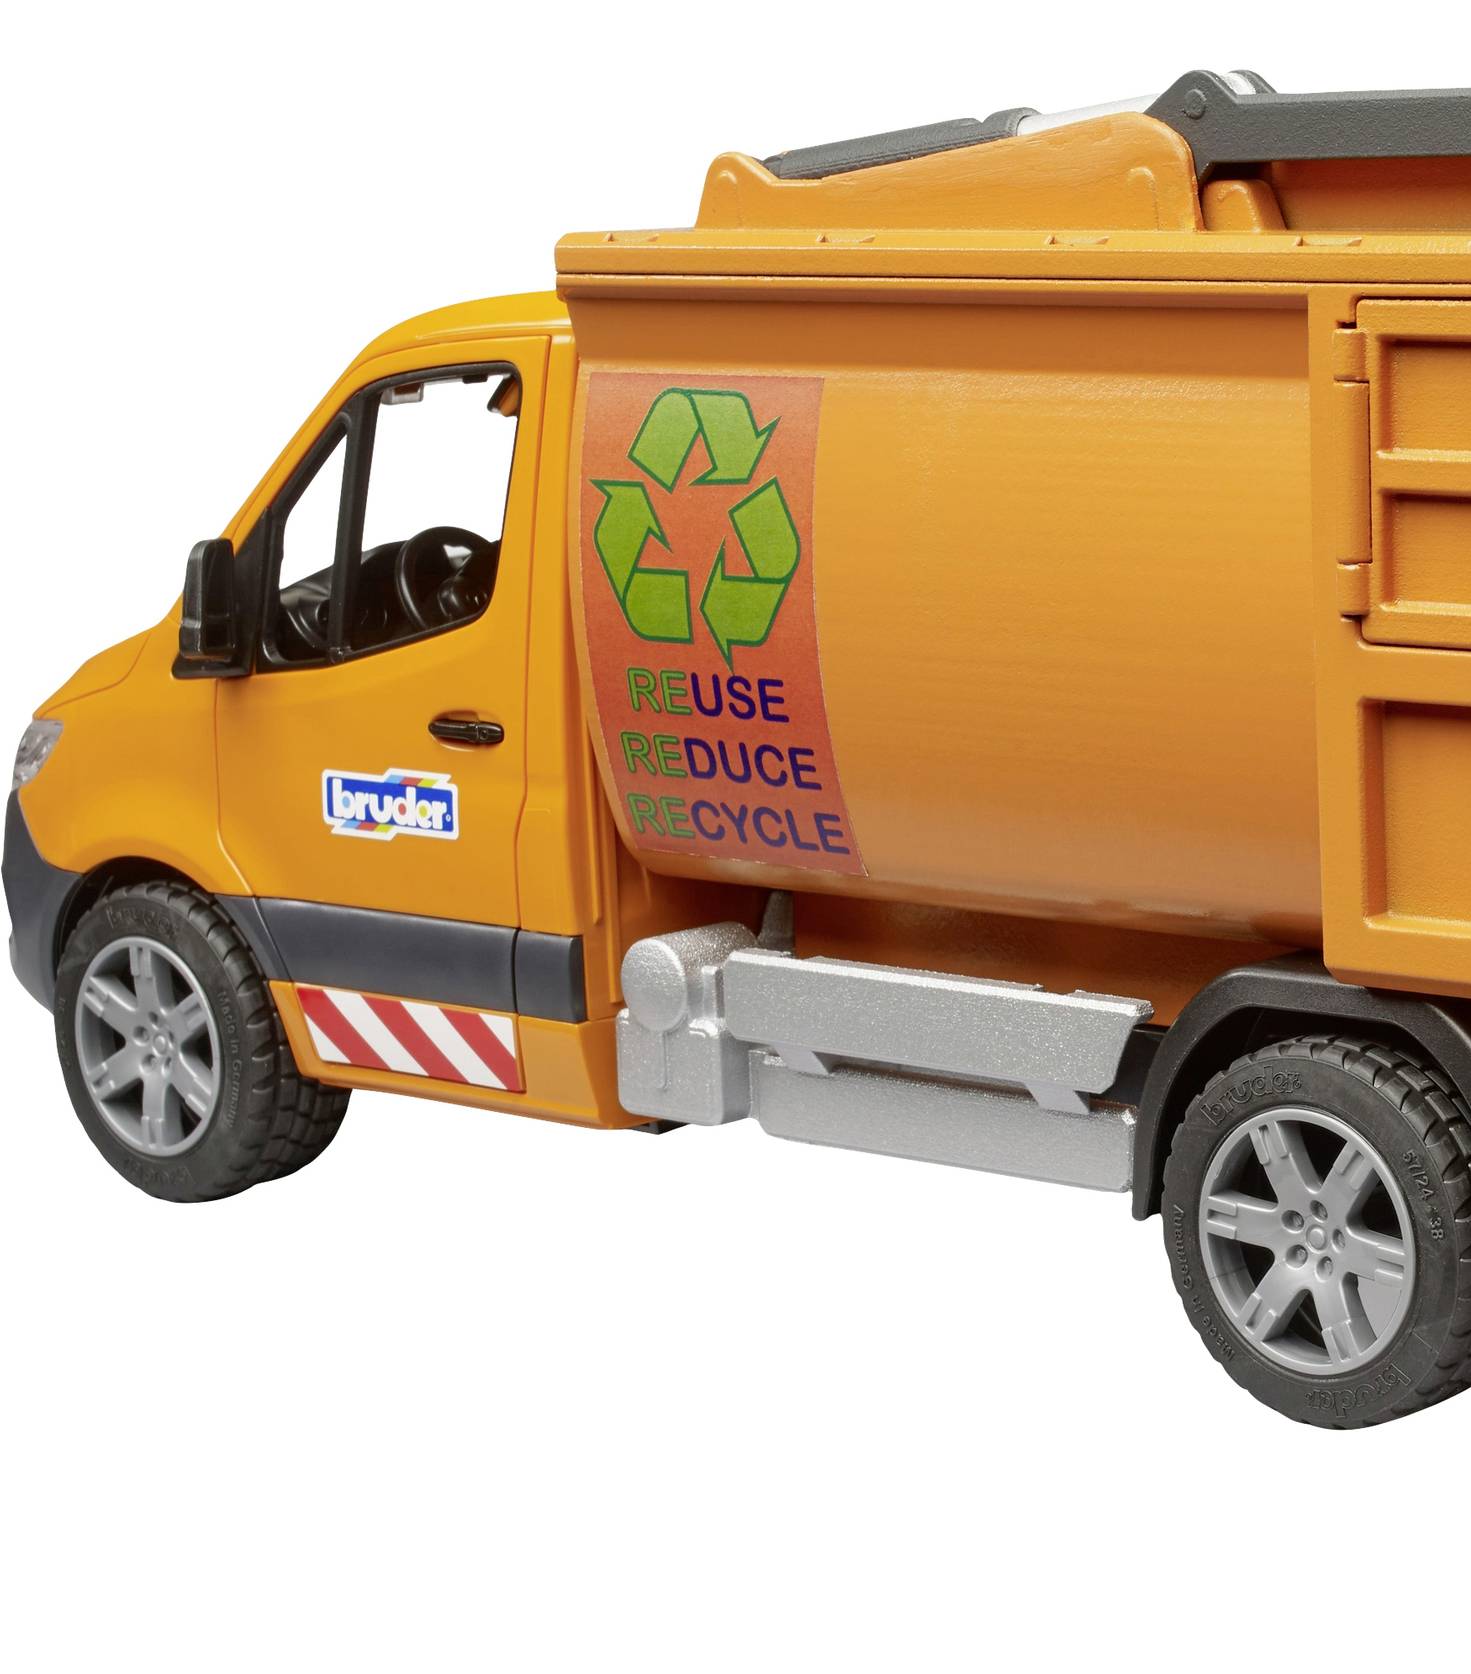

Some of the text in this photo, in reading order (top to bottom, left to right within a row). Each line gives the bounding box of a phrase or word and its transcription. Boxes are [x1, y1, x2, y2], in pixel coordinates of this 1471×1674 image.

[626, 666, 790, 723] REUSE
[619, 731, 822, 790] REDUCE
[332, 778, 447, 830] bruder
[626, 793, 850, 855] RECYCLE
[1200, 1064, 1301, 1127] bruder
